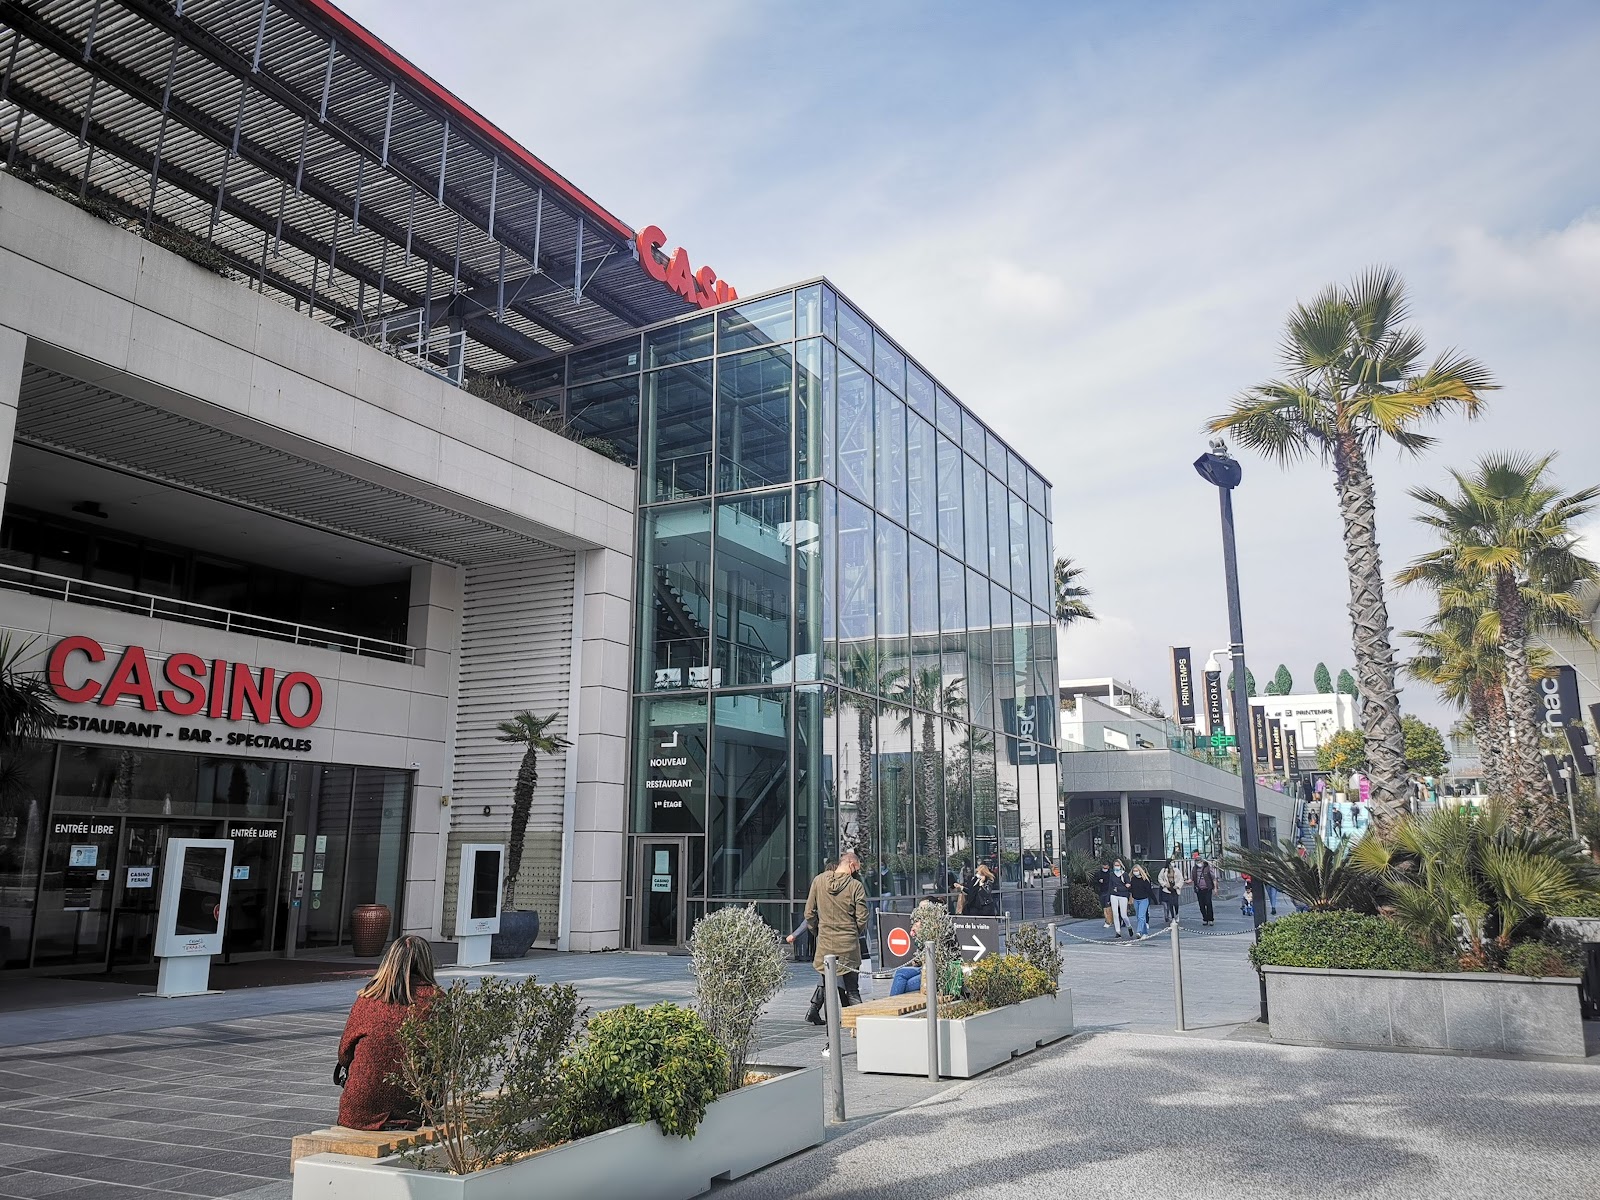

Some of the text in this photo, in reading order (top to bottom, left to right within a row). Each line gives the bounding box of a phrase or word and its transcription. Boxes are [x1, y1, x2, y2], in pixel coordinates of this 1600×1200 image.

[47, 635, 322, 729] CASINO
[1179, 658, 1190, 706] PRINTEMPS
[1210, 681, 1220, 724] SEPHORA
[1541, 677, 1563, 739] fnac
[1295, 708, 1333, 716] PRINTEMPS
[55, 714, 162, 739] ESTAURANT
[179, 727, 212, 743] BAR
[227, 732, 312, 752] SPECTACLES
[650, 757, 687, 767] NOUVEAU
[646, 779, 693, 789] RESTAURANT
[663, 800, 682, 808] ÉTAGE
[55, 822, 114, 834] ENTRÉE LIBRE
[231, 827, 278, 839] ENTRÉE LIBRE
